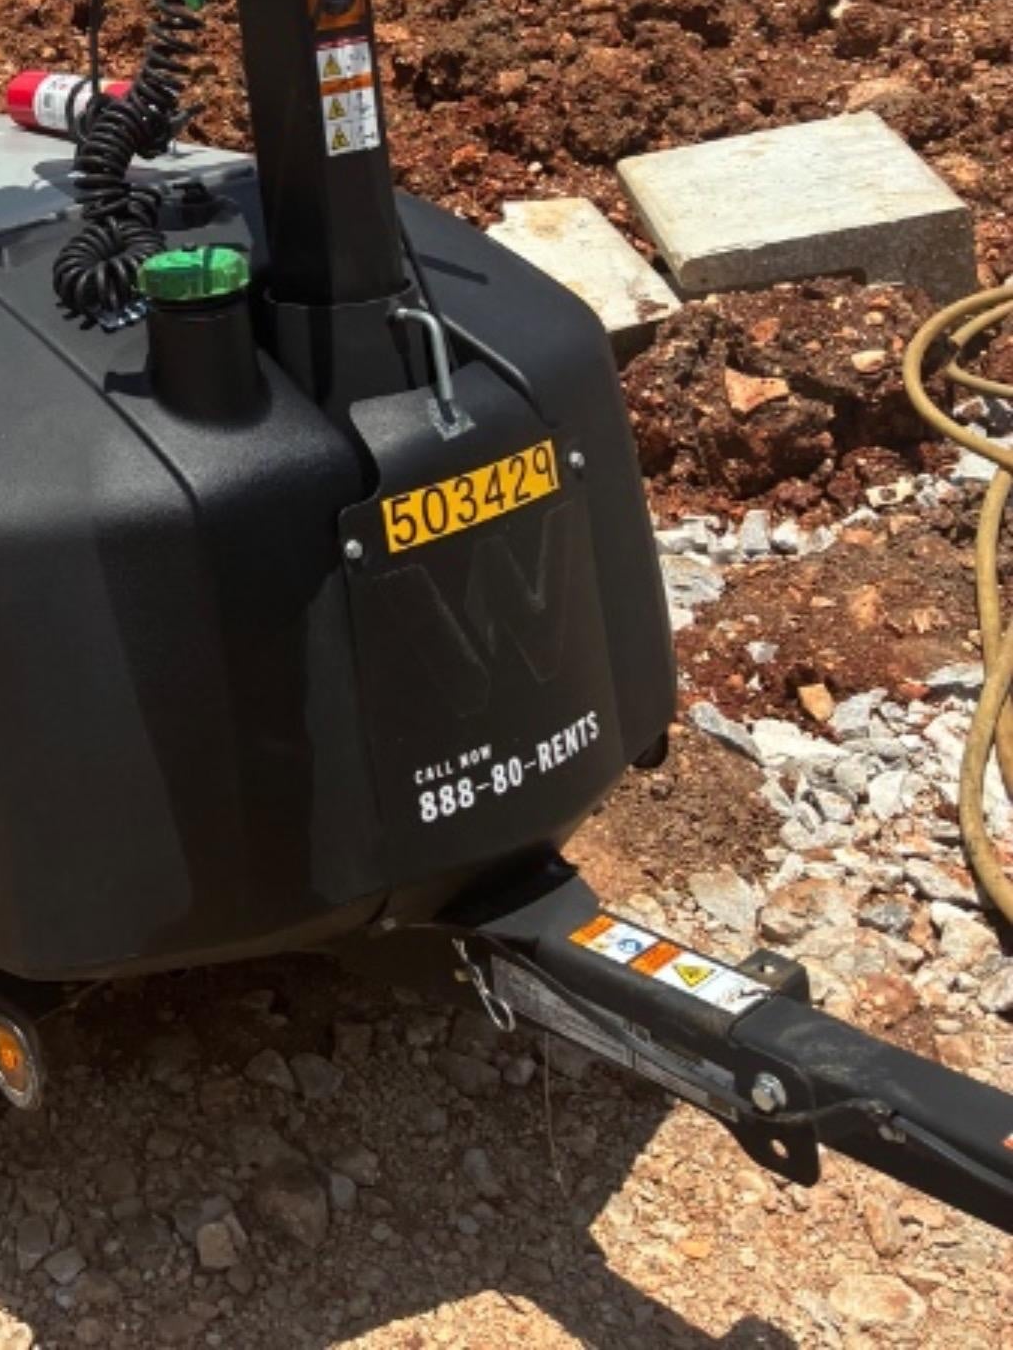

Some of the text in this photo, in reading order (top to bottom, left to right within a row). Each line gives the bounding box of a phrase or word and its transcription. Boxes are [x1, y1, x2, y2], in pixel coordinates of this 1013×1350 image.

[391, 446, 555, 544] 503429
[414, 744, 492, 784] CALL NOW
[419, 711, 599, 822] 888-80-RENTS
